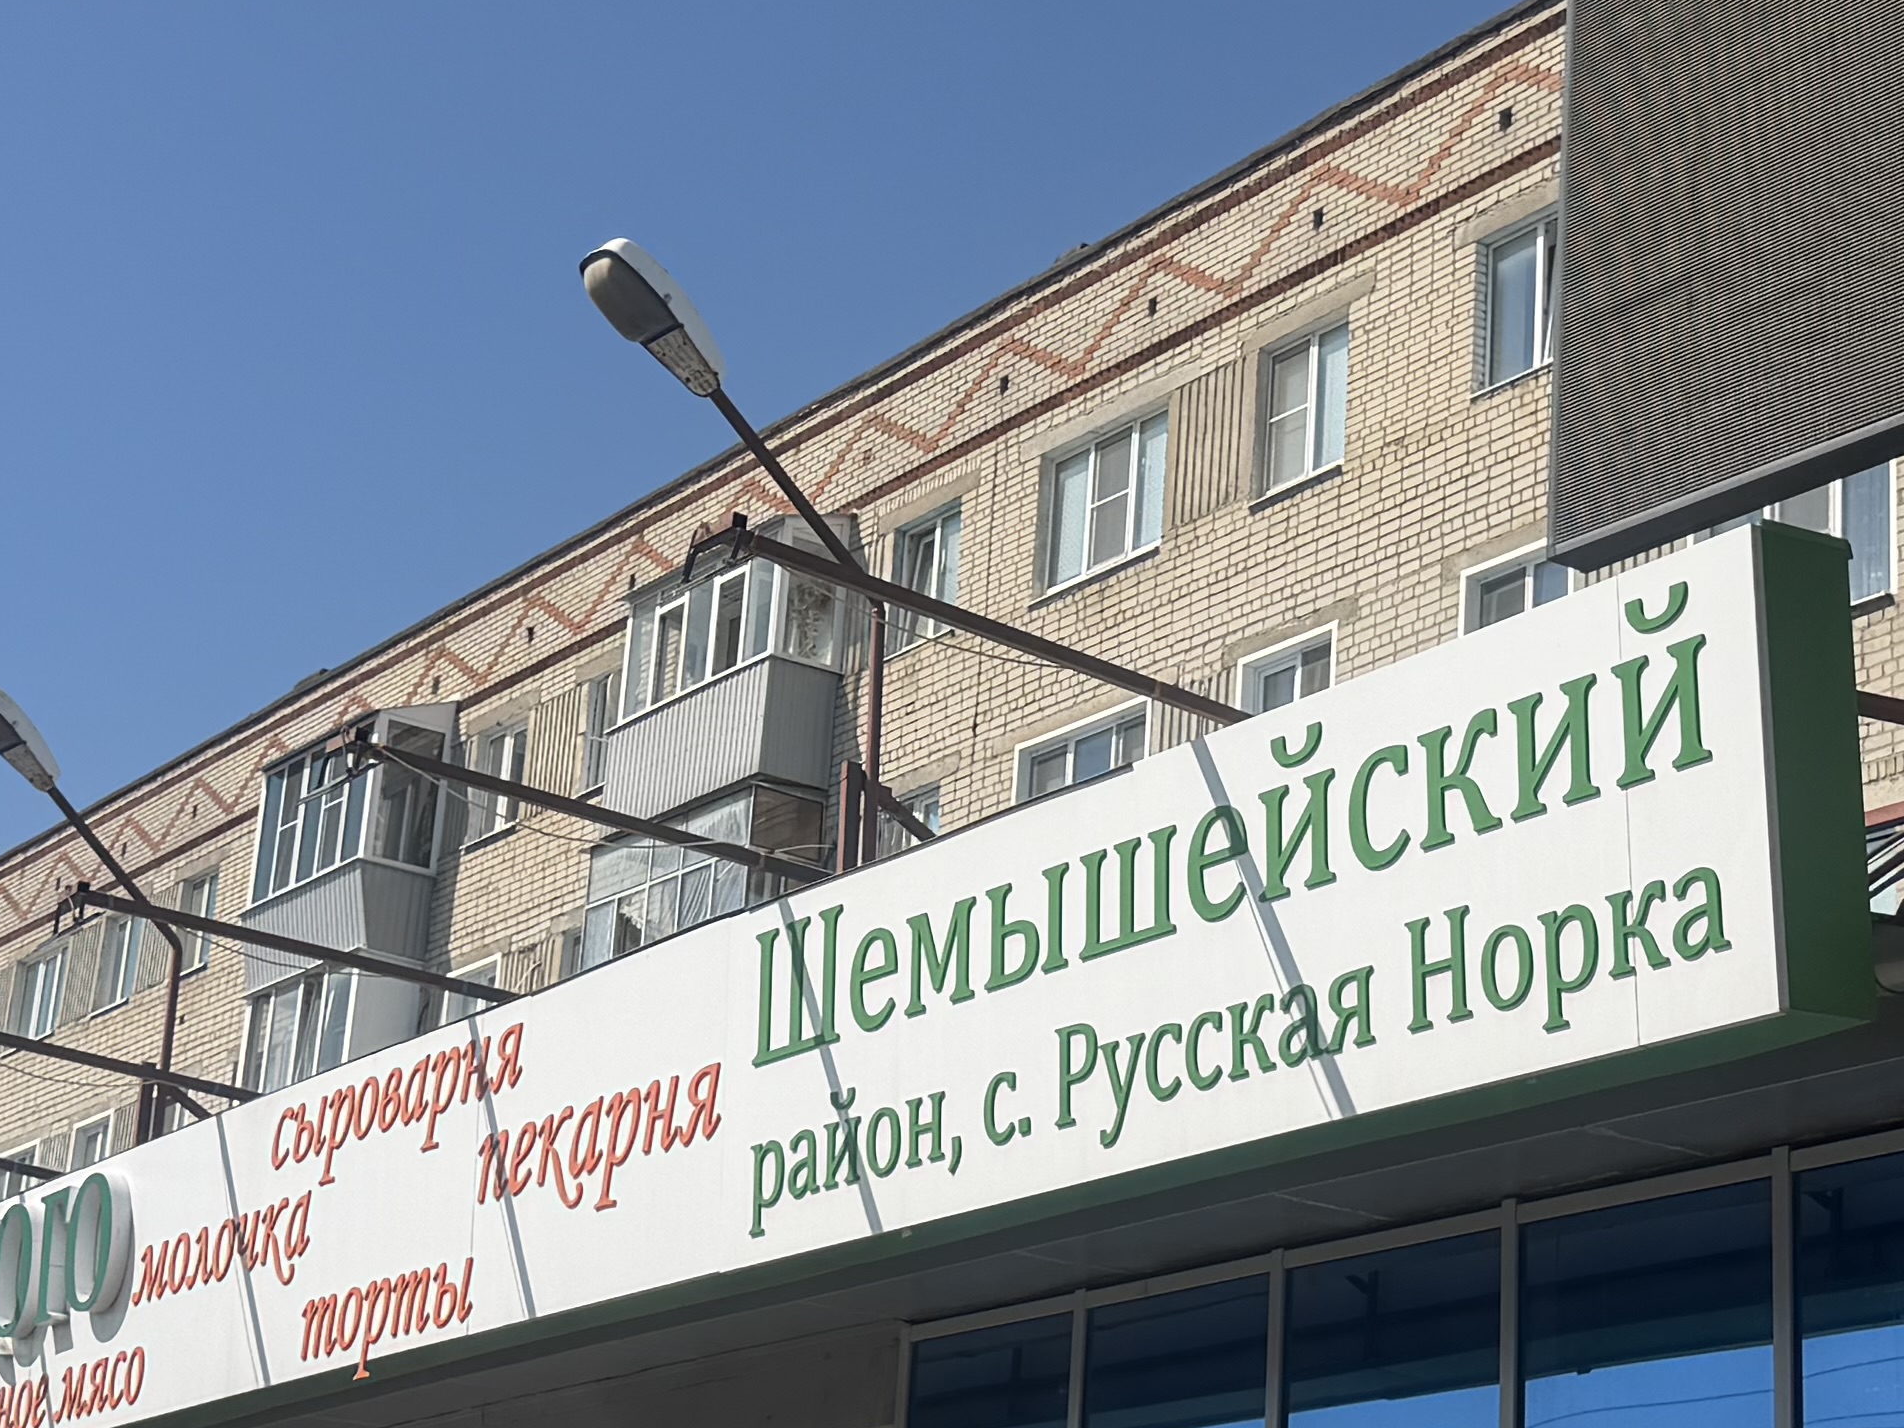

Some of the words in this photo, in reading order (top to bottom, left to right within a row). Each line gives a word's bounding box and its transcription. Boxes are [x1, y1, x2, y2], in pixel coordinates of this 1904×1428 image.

[751, 580, 1714, 1068] Шемышейский
[271, 1022, 525, 1185] сыроварня
[749, 1084, 963, 1238] район,
[983, 1070, 1032, 1145] с.
[1056, 964, 1377, 1149] Русская
[1407, 864, 1731, 1033] Норка
[476, 1062, 722, 1212] пекарня
[132, 1189, 313, 1307] молочка
[301, 1257, 474, 1381] торты
[52, 1346, 146, 1426] мясо
